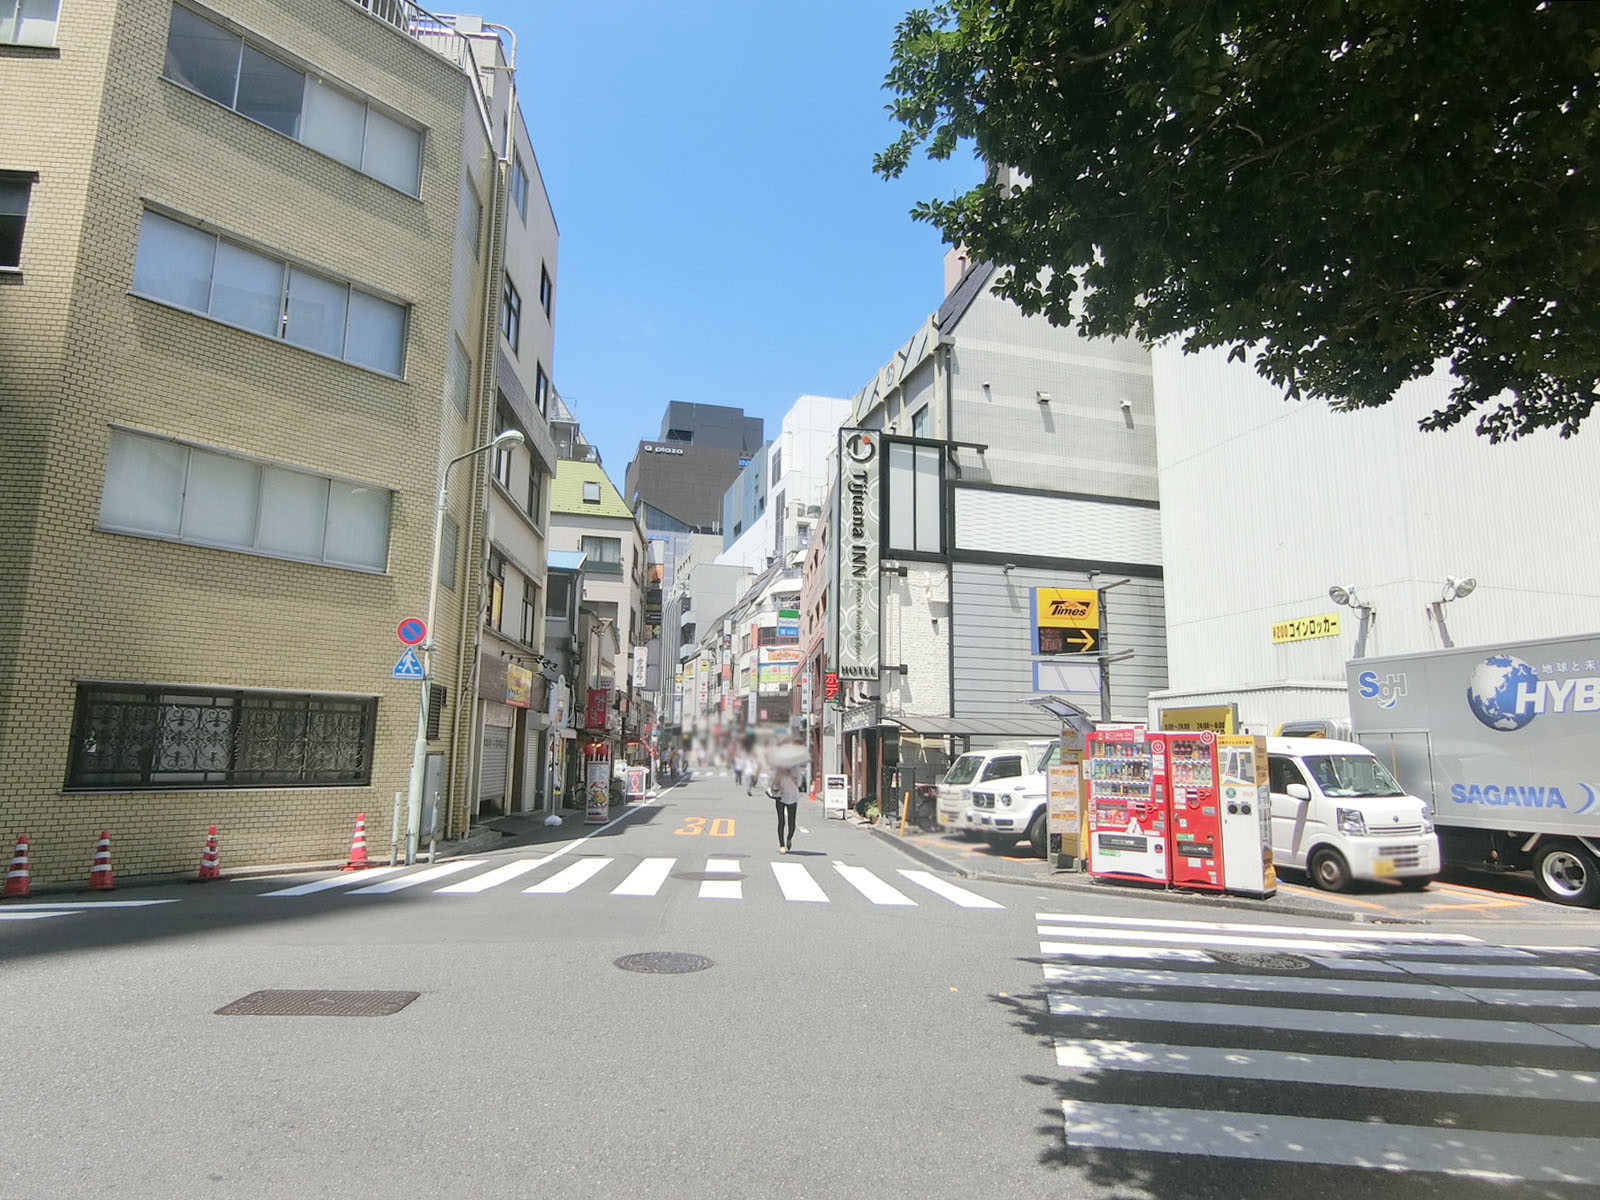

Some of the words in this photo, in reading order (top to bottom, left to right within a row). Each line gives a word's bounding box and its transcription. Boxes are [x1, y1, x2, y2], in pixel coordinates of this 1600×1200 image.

[655, 447, 684, 455] plaza
[847, 471, 868, 539] Tijuana
[851, 545, 867, 578] INN
[1050, 600, 1091, 616] Times
[841, 665, 878, 677] HOTEL
[1451, 783, 1567, 809] SAGAWA
[673, 815, 736, 837] 30
